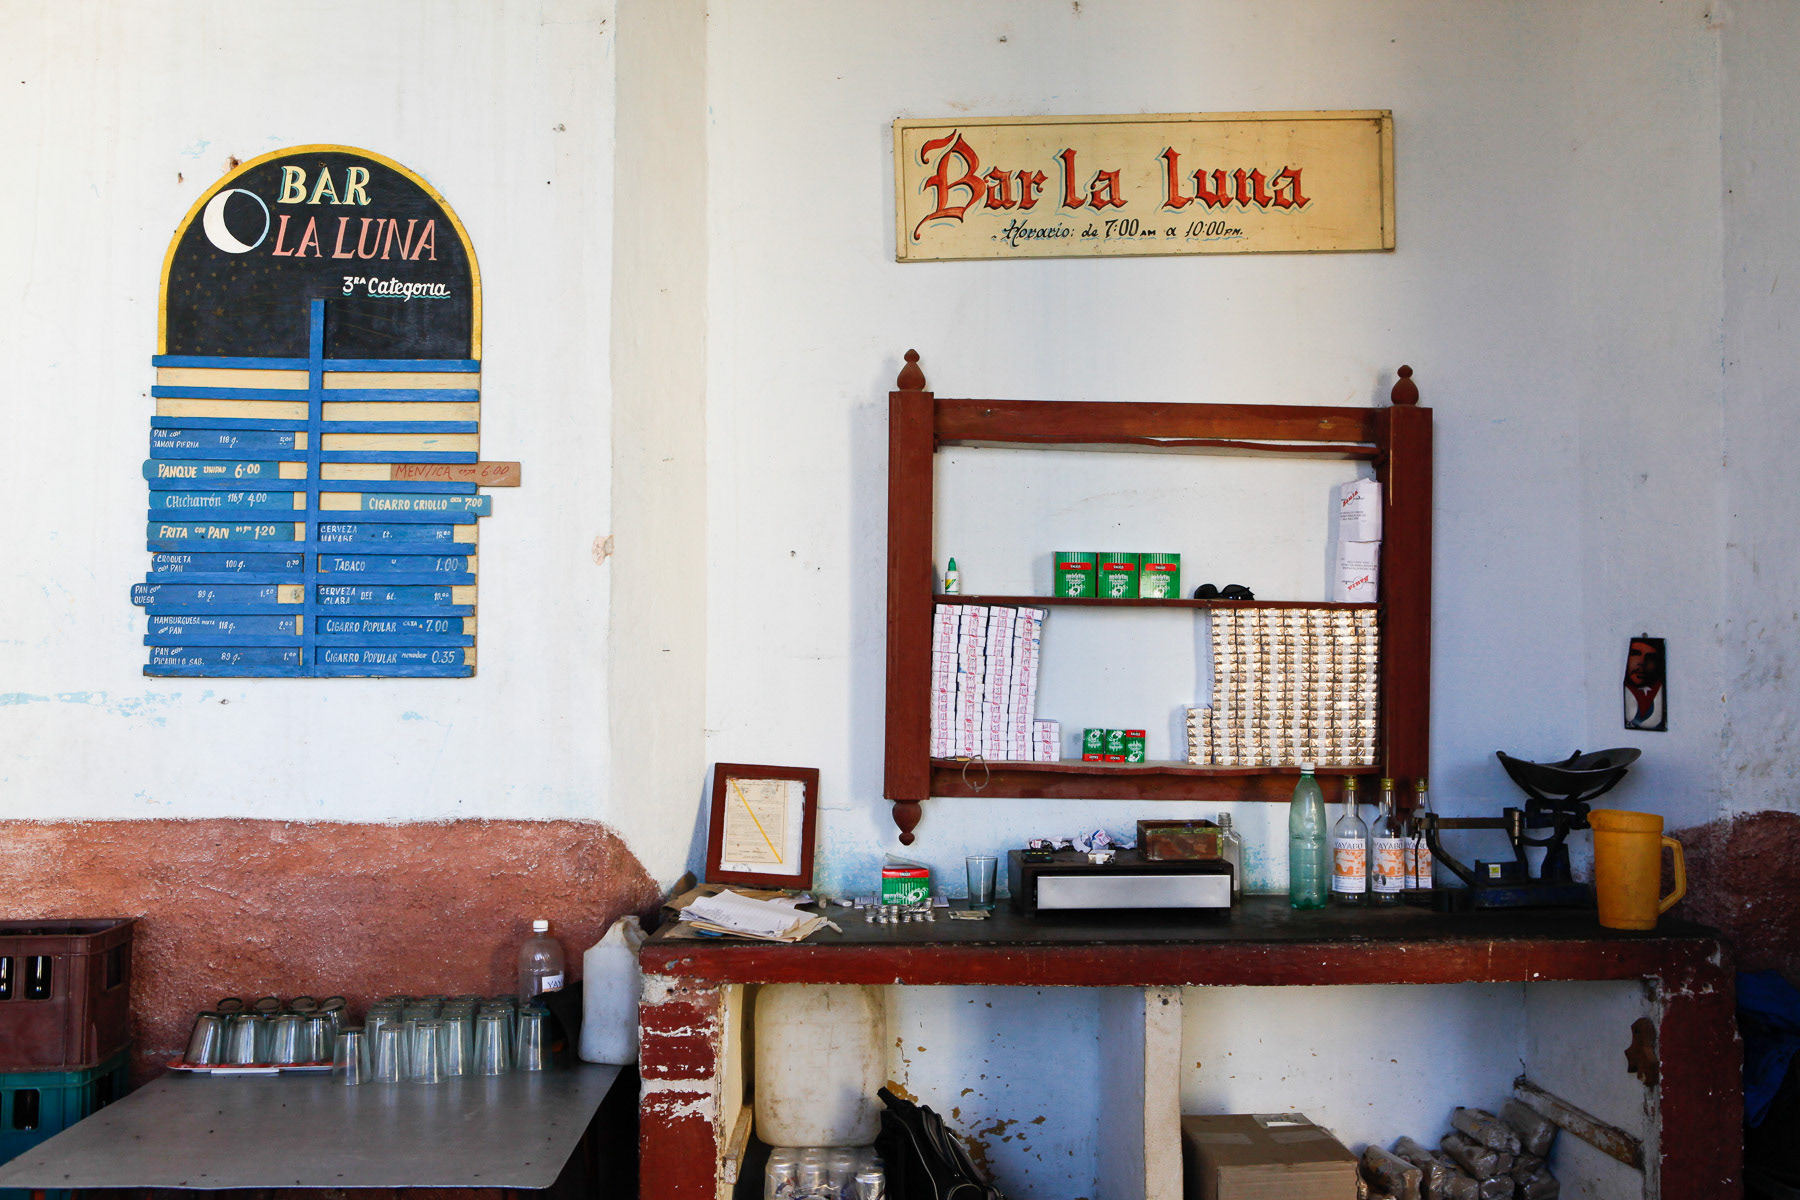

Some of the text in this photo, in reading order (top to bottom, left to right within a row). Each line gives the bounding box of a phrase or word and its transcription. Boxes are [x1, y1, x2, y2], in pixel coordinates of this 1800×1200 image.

[277, 166, 371, 205] BAR
[913, 129, 1049, 241] Bar
[272, 215, 437, 260] LA LUNA
[1001, 219, 1074, 247] Horario:
[1081, 224, 1099, 237] de
[1166, 226, 1176, 237] a
[154, 429, 167, 438] PAN
[158, 464, 198, 478] PANQUE
[247, 493, 267, 507] 4.00
[369, 498, 410, 511] CIGARRO
[413, 499, 448, 511] CRIOLLO
[159, 525, 188, 539] FRITA
[207, 526, 229, 539] PAN
[254, 525, 276, 540] 1.20
[320, 525, 357, 533] CERVEZA
[157, 555, 191, 563] CROQUETA
[170, 564, 183, 573] PAN
[334, 558, 366, 572] TABACO
[435, 558, 458, 571] 1.00
[135, 586, 148, 594] PAN
[320, 587, 356, 595] CERVEZA
[134, 596, 155, 604] QUESO
[323, 597, 351, 605] CLARA
[154, 616, 200, 625] HAMBURGUESA
[326, 619, 360, 632] CIGARRO
[362, 620, 397, 632] POPULAR
[426, 619, 449, 632] 7.00
[169, 626, 183, 635] PAN
[155, 647, 169, 656] PAN
[325, 650, 360, 663] CIGARRO
[362, 651, 398, 664] POPULAR
[431, 650, 456, 664] 0.35
